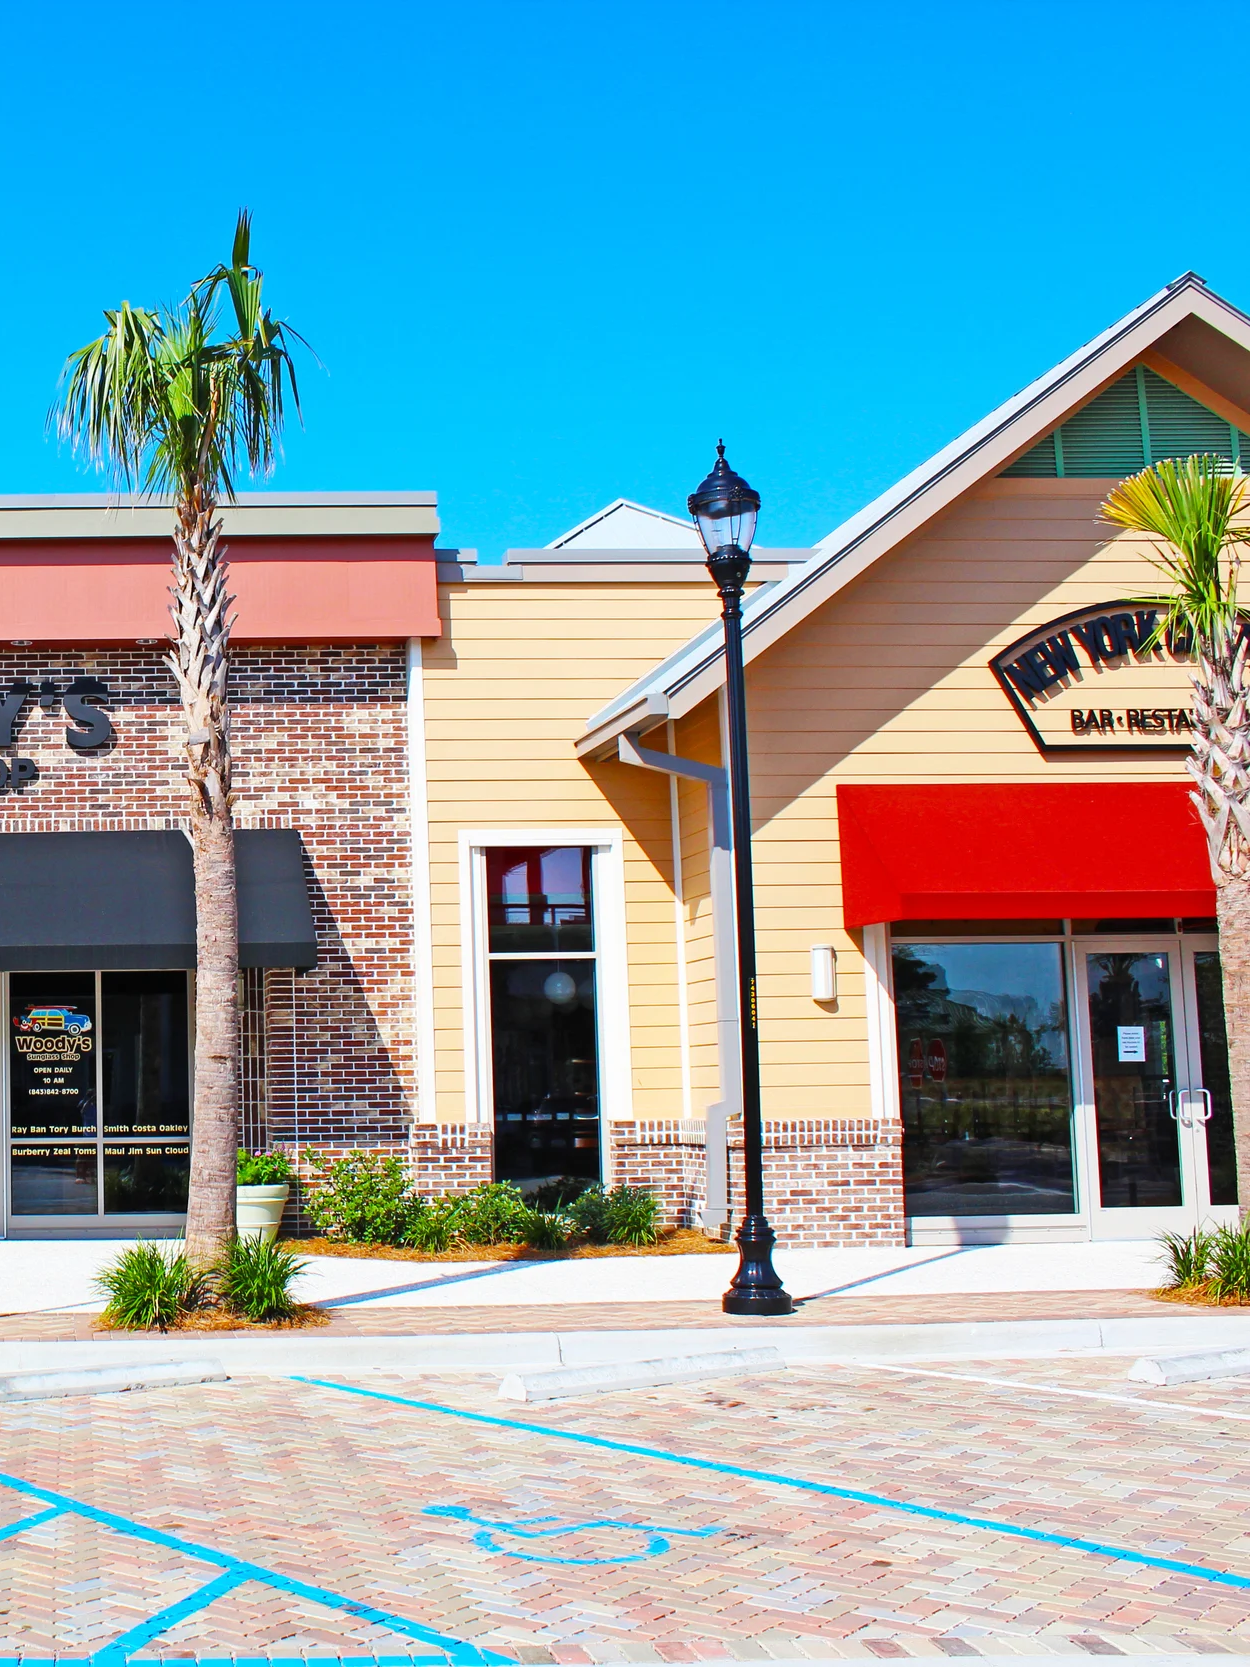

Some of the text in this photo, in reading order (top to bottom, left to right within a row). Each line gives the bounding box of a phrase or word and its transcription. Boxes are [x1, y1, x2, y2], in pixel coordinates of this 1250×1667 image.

[1004, 629, 1081, 700] NEW
[1069, 609, 1163, 663] YORK
[1070, 709, 1195, 730] BAR RESTA
[15, 1035, 92, 1054] Woody's
[27, 1053, 80, 1061] Sunglass Shop
[11, 1126, 27, 1135] Ray
[49, 1126, 69, 1135] Tory
[71, 1125, 97, 1133] Burch
[103, 1125, 129, 1133] Smith
[159, 1124, 188, 1133] Oakley
[12, 1148, 50, 1157] Burberry
[74, 1147, 97, 1155] Toms
[104, 1146, 189, 1155] Maui Jim Sun Cloud
